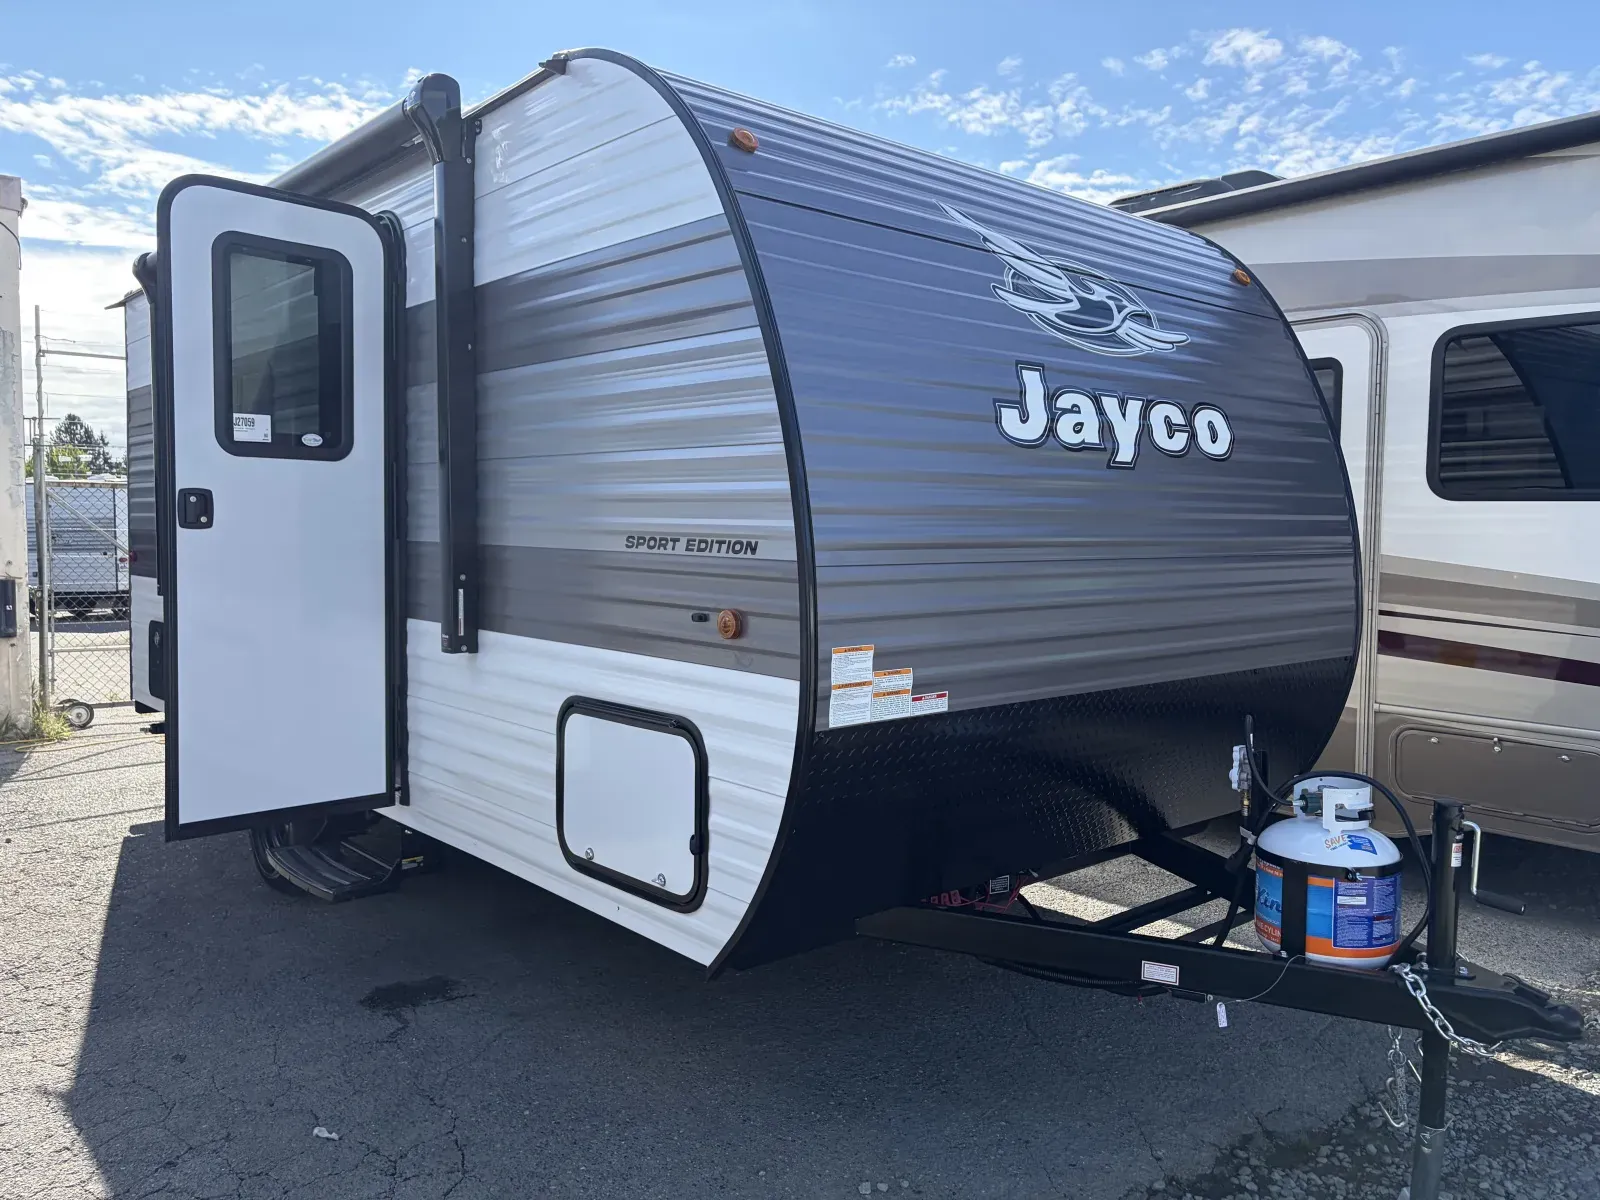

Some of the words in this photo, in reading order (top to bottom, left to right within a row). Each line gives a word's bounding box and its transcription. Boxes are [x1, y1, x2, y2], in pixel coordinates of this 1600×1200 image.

[233, 416, 255, 428] J27059
[994, 361, 1234, 469] Jayco
[625, 535, 680, 551] SPORT
[685, 538, 759, 556] EDITION
[1324, 834, 1347, 849] SAVE
